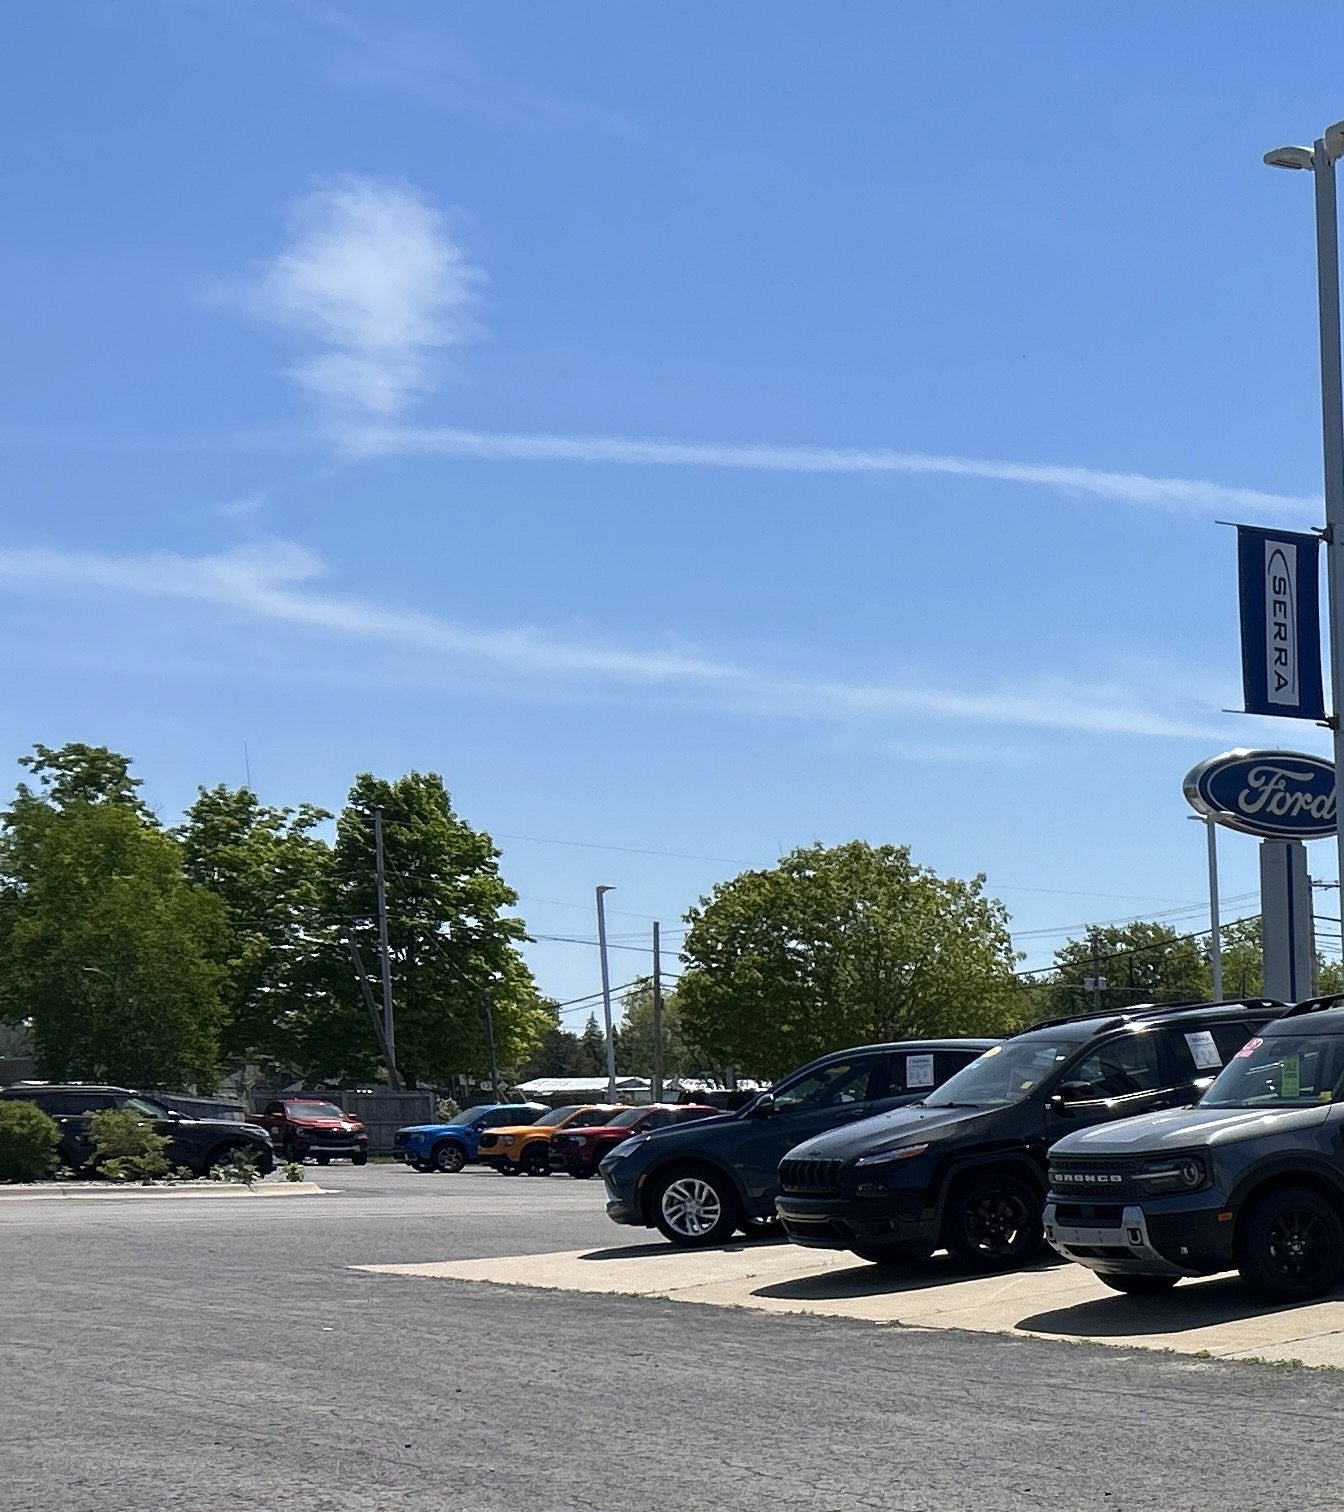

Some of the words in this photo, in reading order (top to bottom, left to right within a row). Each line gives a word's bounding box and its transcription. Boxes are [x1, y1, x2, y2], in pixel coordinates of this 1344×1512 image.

[1272, 575, 1289, 693] SERRA
[1238, 765, 1337, 821] Ford
[1054, 1173, 1122, 1182] BRONCO
